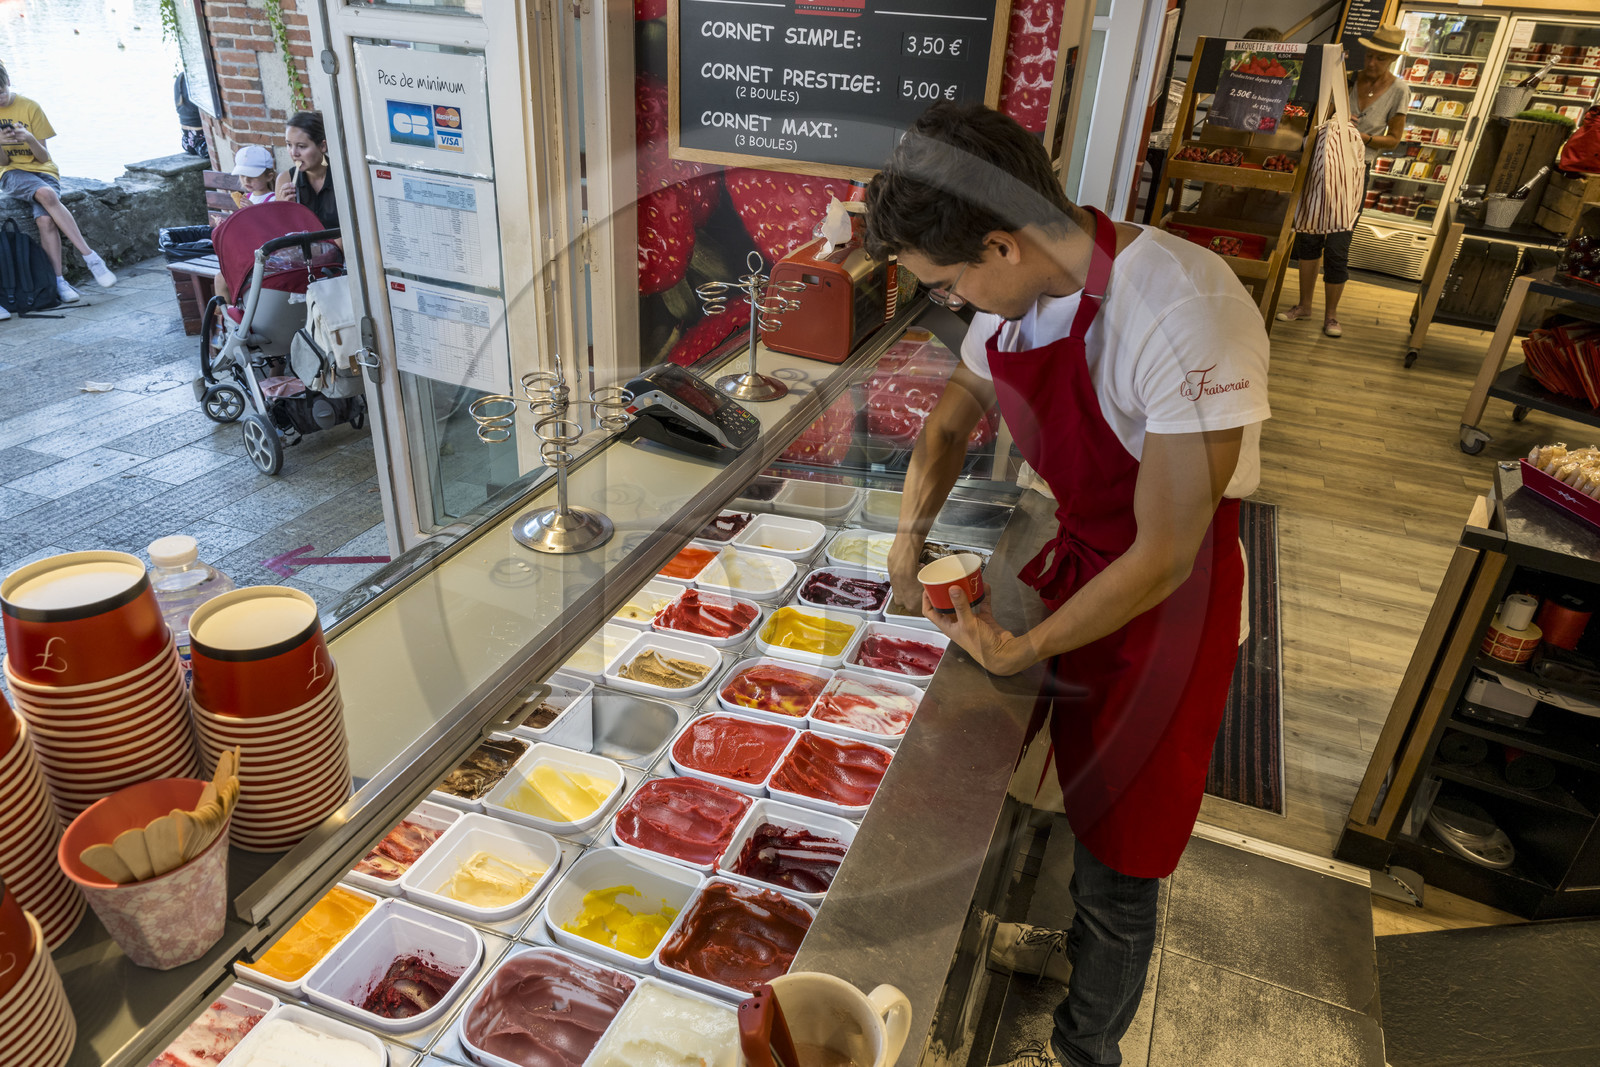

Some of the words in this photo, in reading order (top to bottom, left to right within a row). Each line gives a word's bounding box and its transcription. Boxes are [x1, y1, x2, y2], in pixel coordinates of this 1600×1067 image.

[701, 21, 775, 42] CORNET
[785, 27, 861, 49] SIMPLE:
[907, 36, 945, 56] 3,50
[949, 39, 962, 56] €
[1234, 42, 1265, 51] BARQUETTE
[1273, 43, 1299, 53] FRAISES
[377, 69, 397, 86] Pas
[400, 73, 414, 88] de
[417, 75, 466, 94] minimum
[701, 62, 773, 84] CORNET
[783, 69, 881, 94] PRESTIGE:
[736, 86, 747, 99] (2
[750, 87, 800, 104] BOULES)
[902, 80, 940, 101] 5,00
[944, 85, 957, 101] €
[1229, 88, 1252, 98] 2,50€
[701, 111, 771, 132] CORNET
[781, 118, 838, 139] MAXI:
[441, 136, 460, 146] VISA
[734, 134, 746, 148] (3
[749, 136, 798, 153] BOULES)
[1180, 380, 1193, 397] la
[1185, 363, 1250, 401] Fraiseraie
